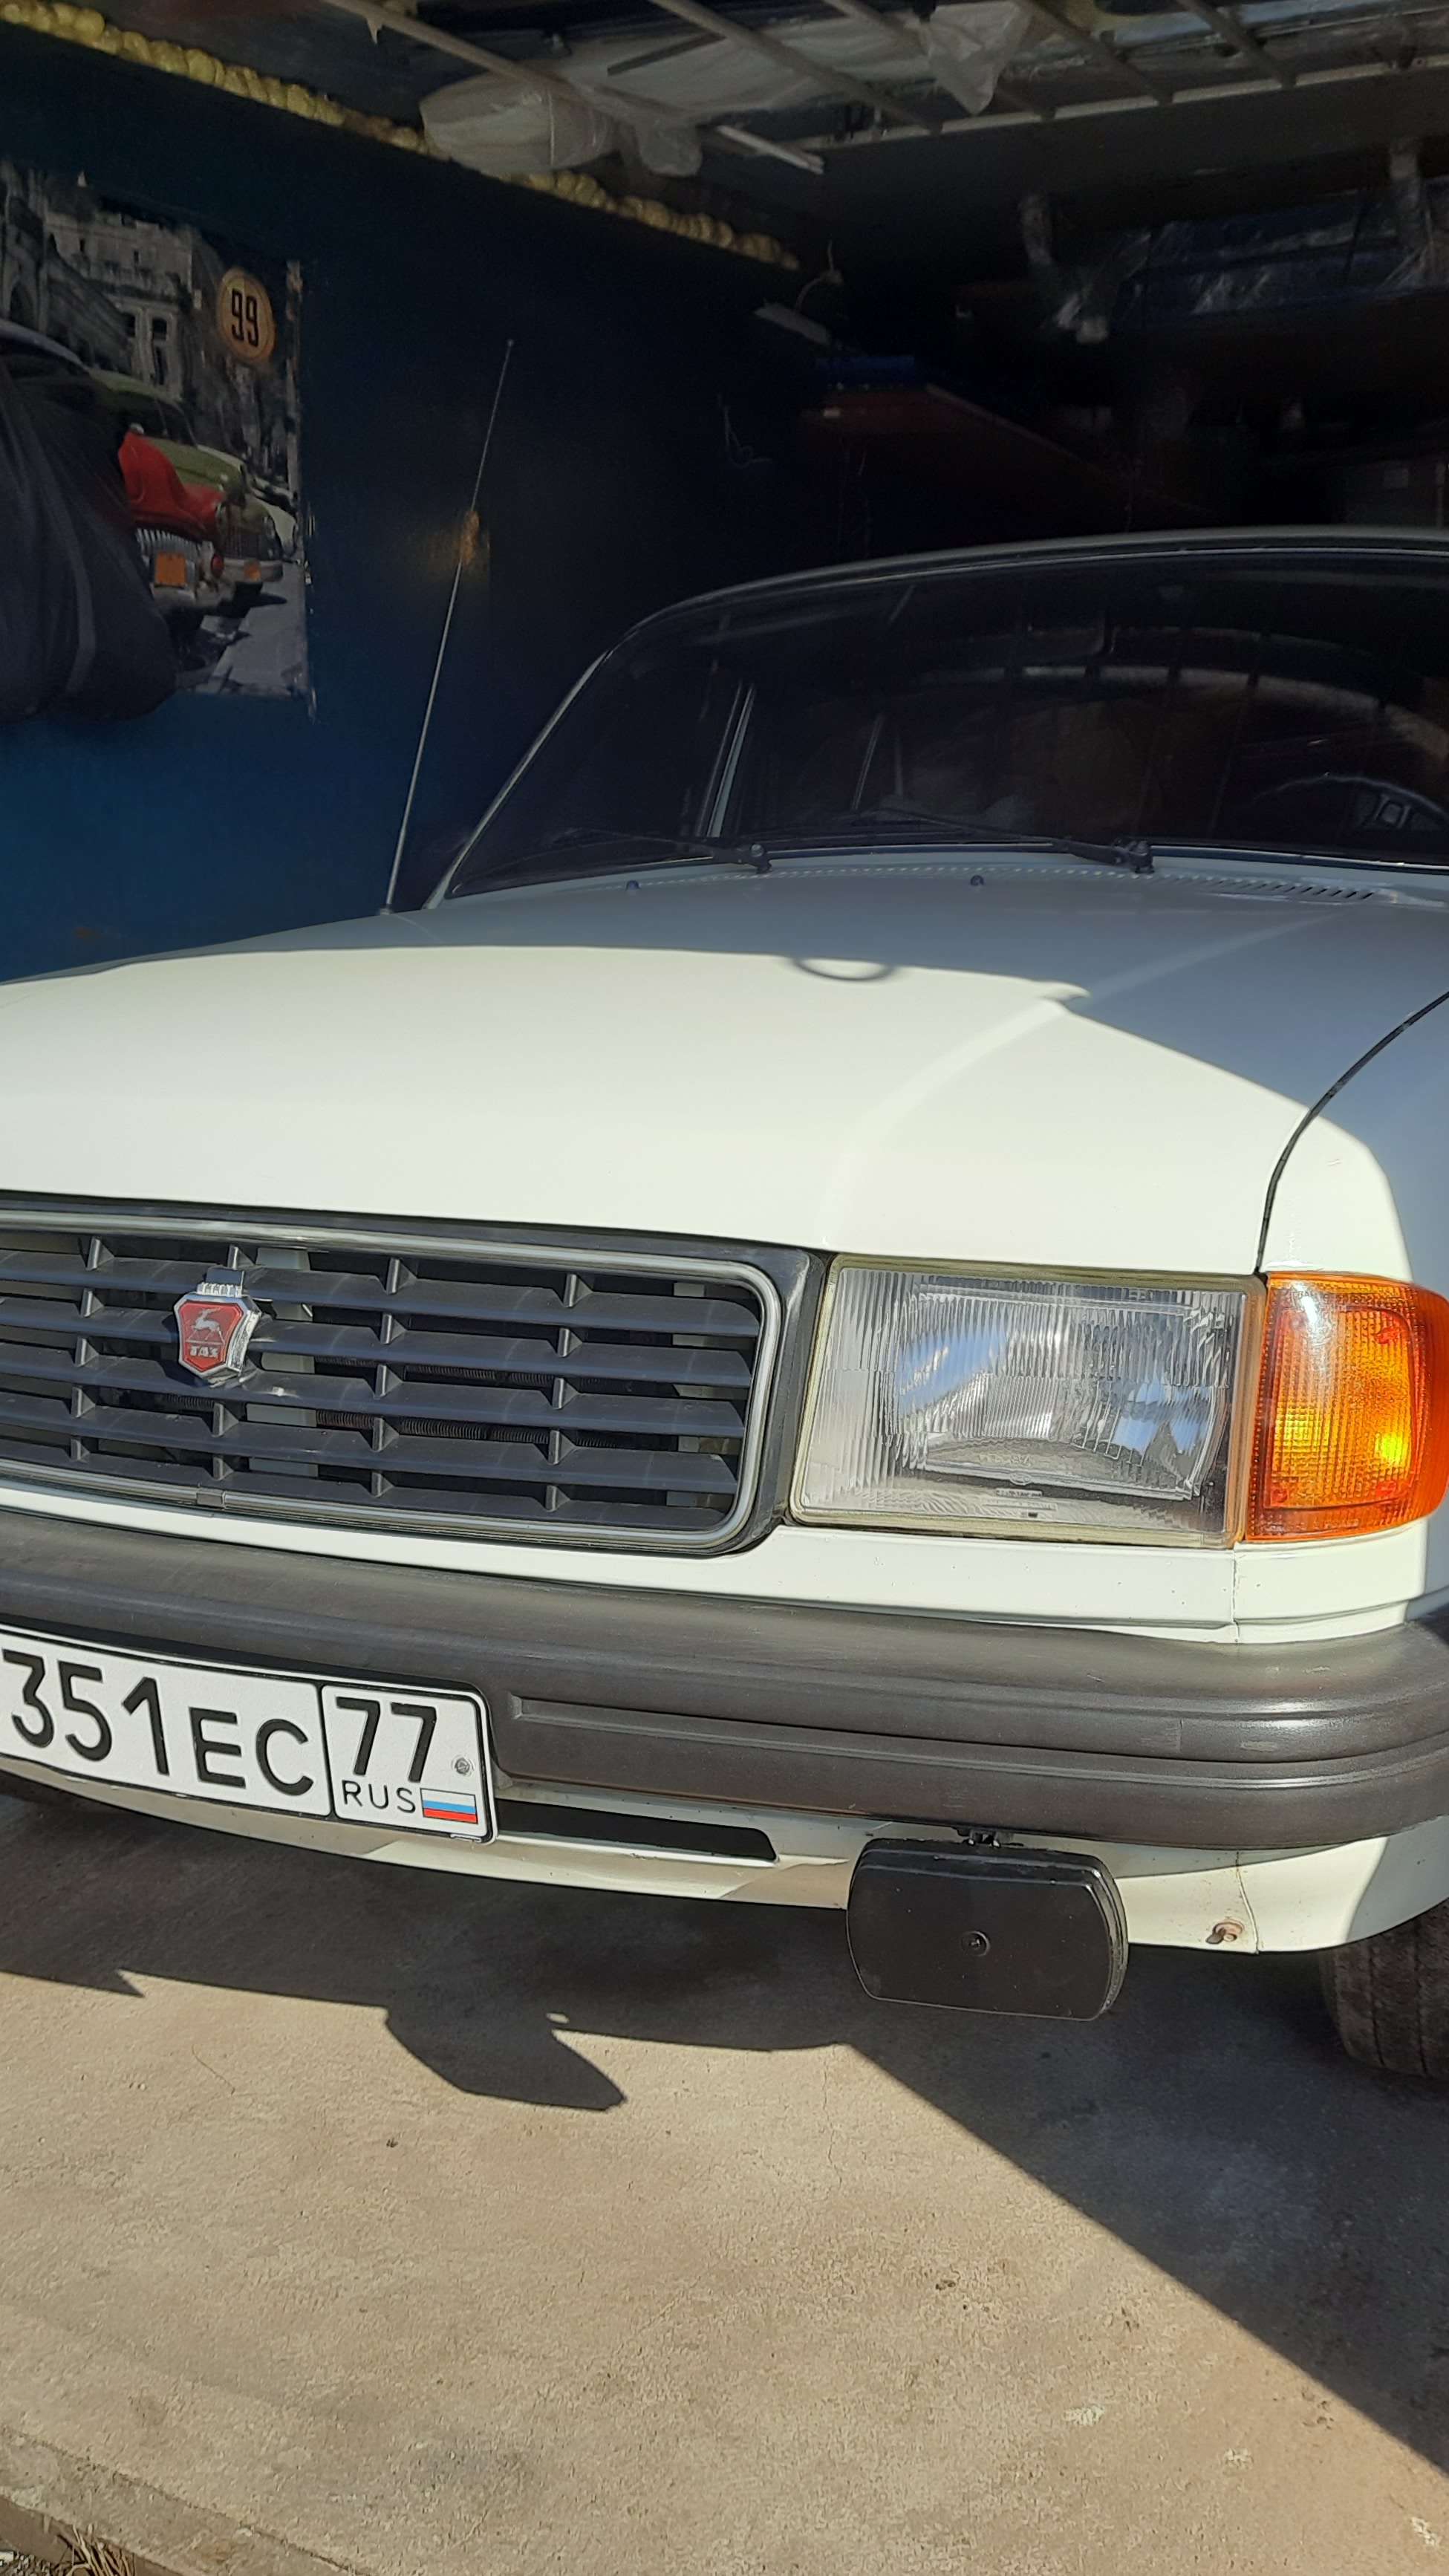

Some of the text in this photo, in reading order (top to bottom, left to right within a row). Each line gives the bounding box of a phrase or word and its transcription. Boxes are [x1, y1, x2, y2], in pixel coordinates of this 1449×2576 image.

[232, 287, 258, 347] 99
[335, 1697, 437, 1783] 77
[342, 1780, 416, 1814] RUS
